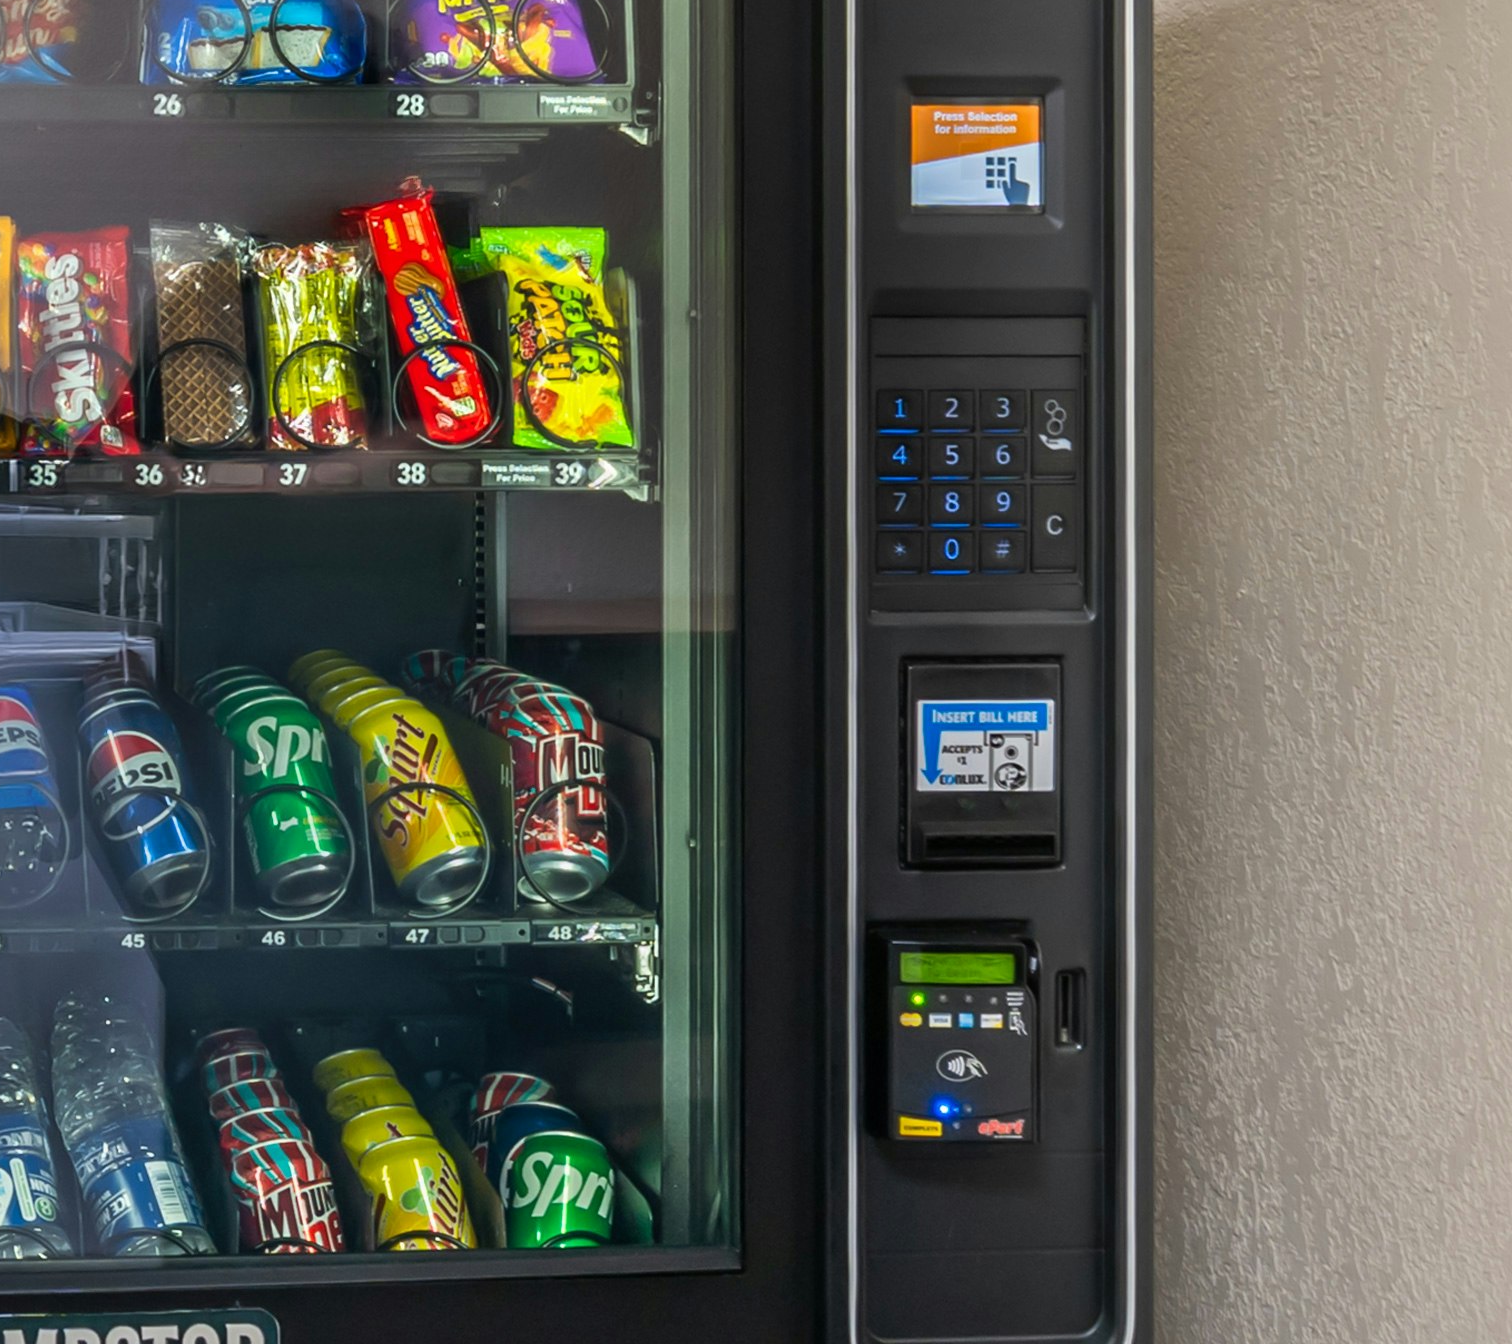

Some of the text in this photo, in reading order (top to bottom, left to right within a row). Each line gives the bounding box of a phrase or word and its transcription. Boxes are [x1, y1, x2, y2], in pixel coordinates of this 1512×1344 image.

[154, 94, 182, 115] 26
[397, 94, 424, 116] 28
[934, 112, 1017, 121] Press Selection
[935, 124, 951, 134] for
[520, 279, 572, 380] PATCH
[551, 284, 601, 373] SOUR
[894, 398, 906, 418] 1
[945, 398, 958, 417] 2
[997, 398, 1010, 418] 3
[892, 445, 907, 464] 4
[946, 445, 959, 464] 5
[996, 445, 1010, 464] 6
[30, 465, 57, 486] 35
[135, 464, 163, 485] 36
[279, 463, 307, 485] 37
[397, 463, 425, 485] 38
[556, 461, 582, 484] 39
[893, 492, 907, 512] 7
[945, 492, 959, 512] 8
[996, 492, 1010, 512] 9
[1047, 515, 1063, 535] C
[945, 539, 959, 559] 0
[932, 709, 1038, 723] INSERT BILL HERE
[942, 745, 983, 754] ACCEPTS
[122, 934, 145, 948] 45
[262, 931, 285, 946] 46
[406, 928, 429, 943] 47
[548, 926, 572, 941] 48
